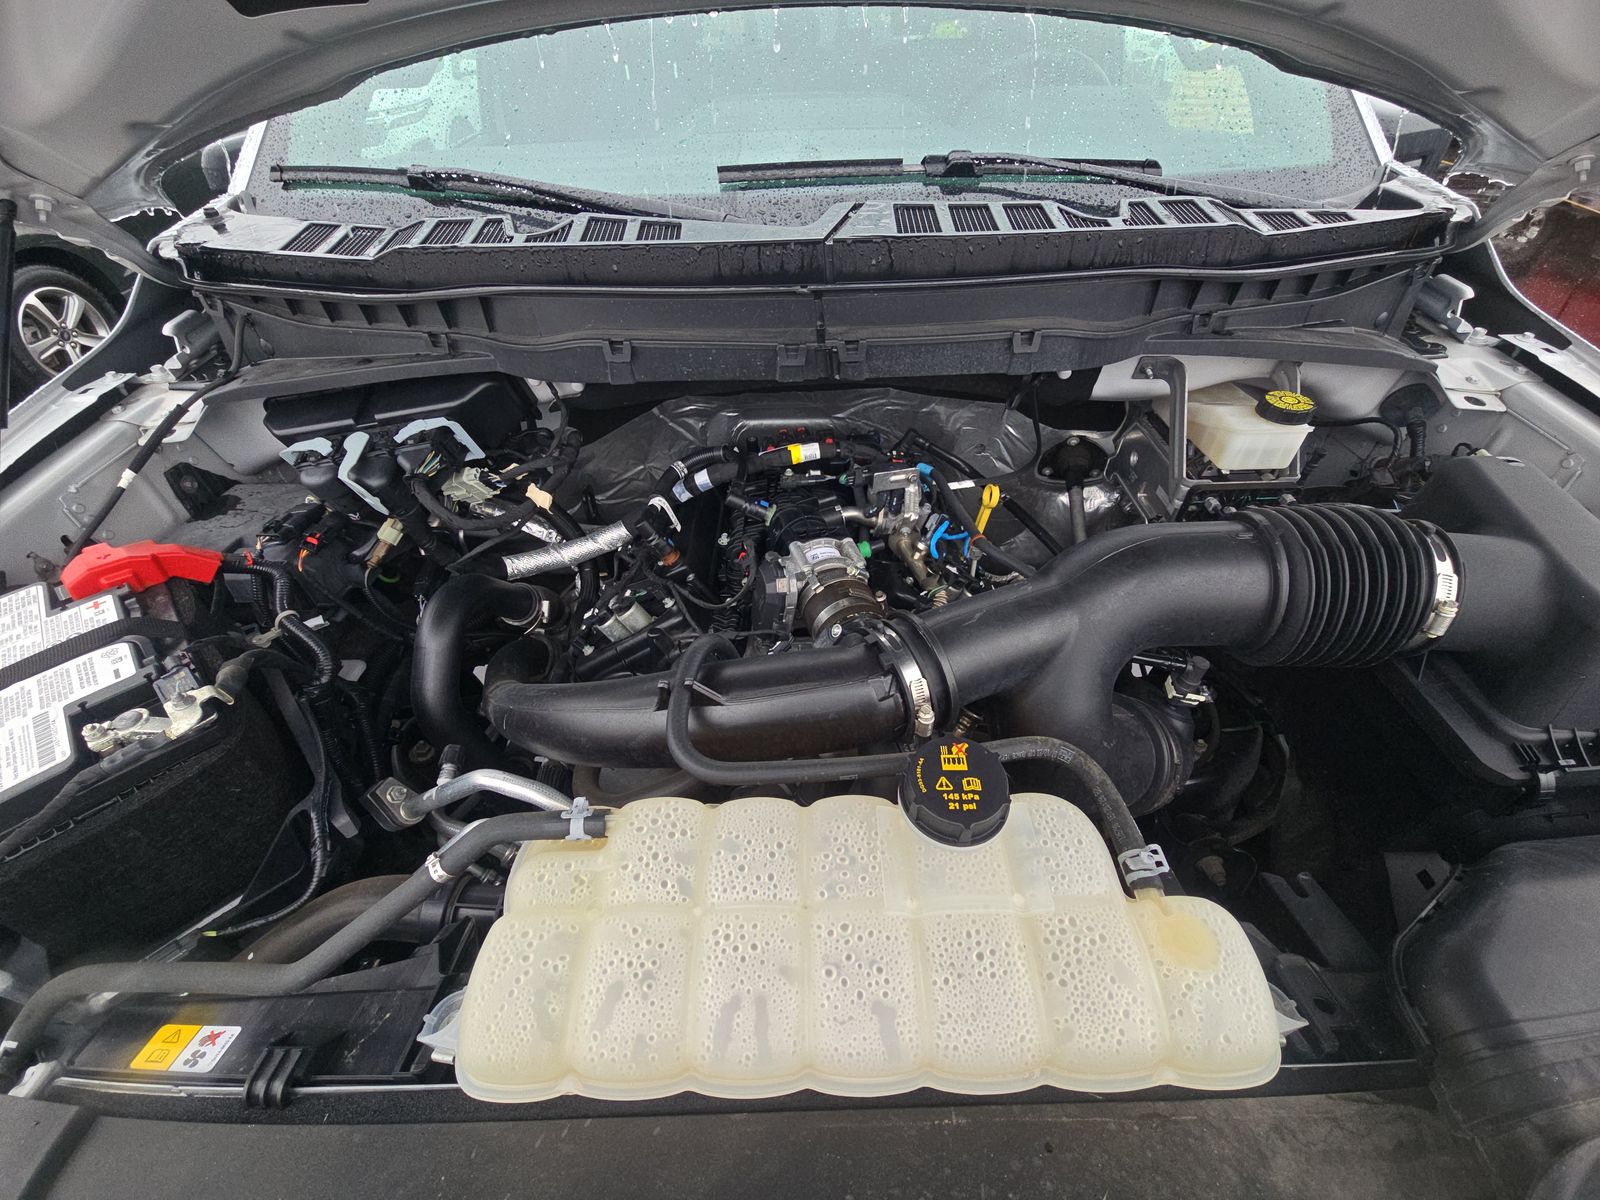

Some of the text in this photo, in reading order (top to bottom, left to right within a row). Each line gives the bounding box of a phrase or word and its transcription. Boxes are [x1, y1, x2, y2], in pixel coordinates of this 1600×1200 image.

[942, 792, 980, 800] 145 kPa
[948, 802, 977, 811] 21 psi
